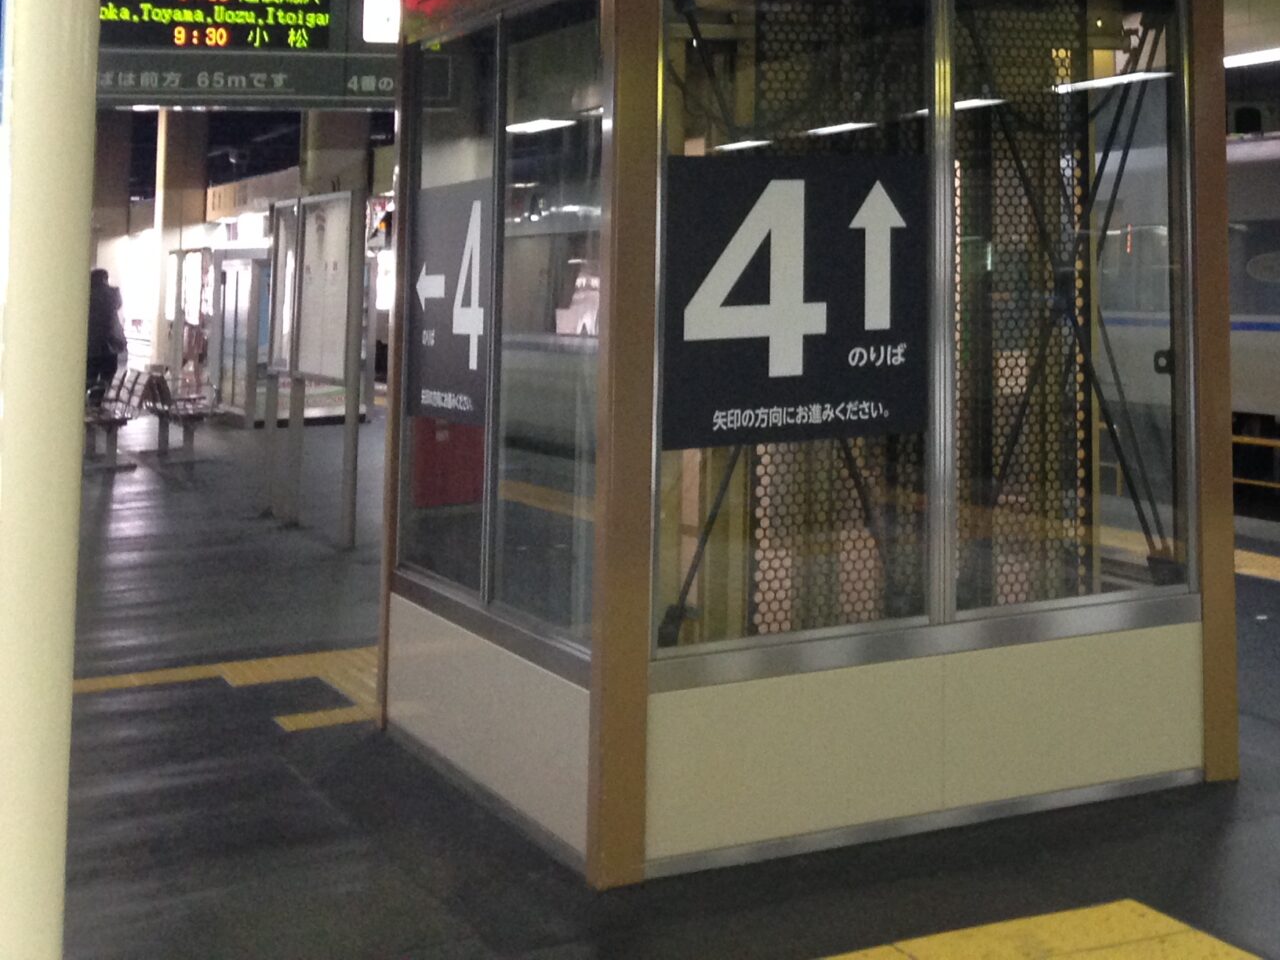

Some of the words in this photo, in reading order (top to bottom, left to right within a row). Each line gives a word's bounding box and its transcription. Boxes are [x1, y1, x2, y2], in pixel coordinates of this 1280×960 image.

[453, 200, 484, 371] 4
[684, 179, 827, 378] 4
[848, 343, 907, 367] のりば
[712, 401, 890, 431] 矢印の方向にお進みください。
